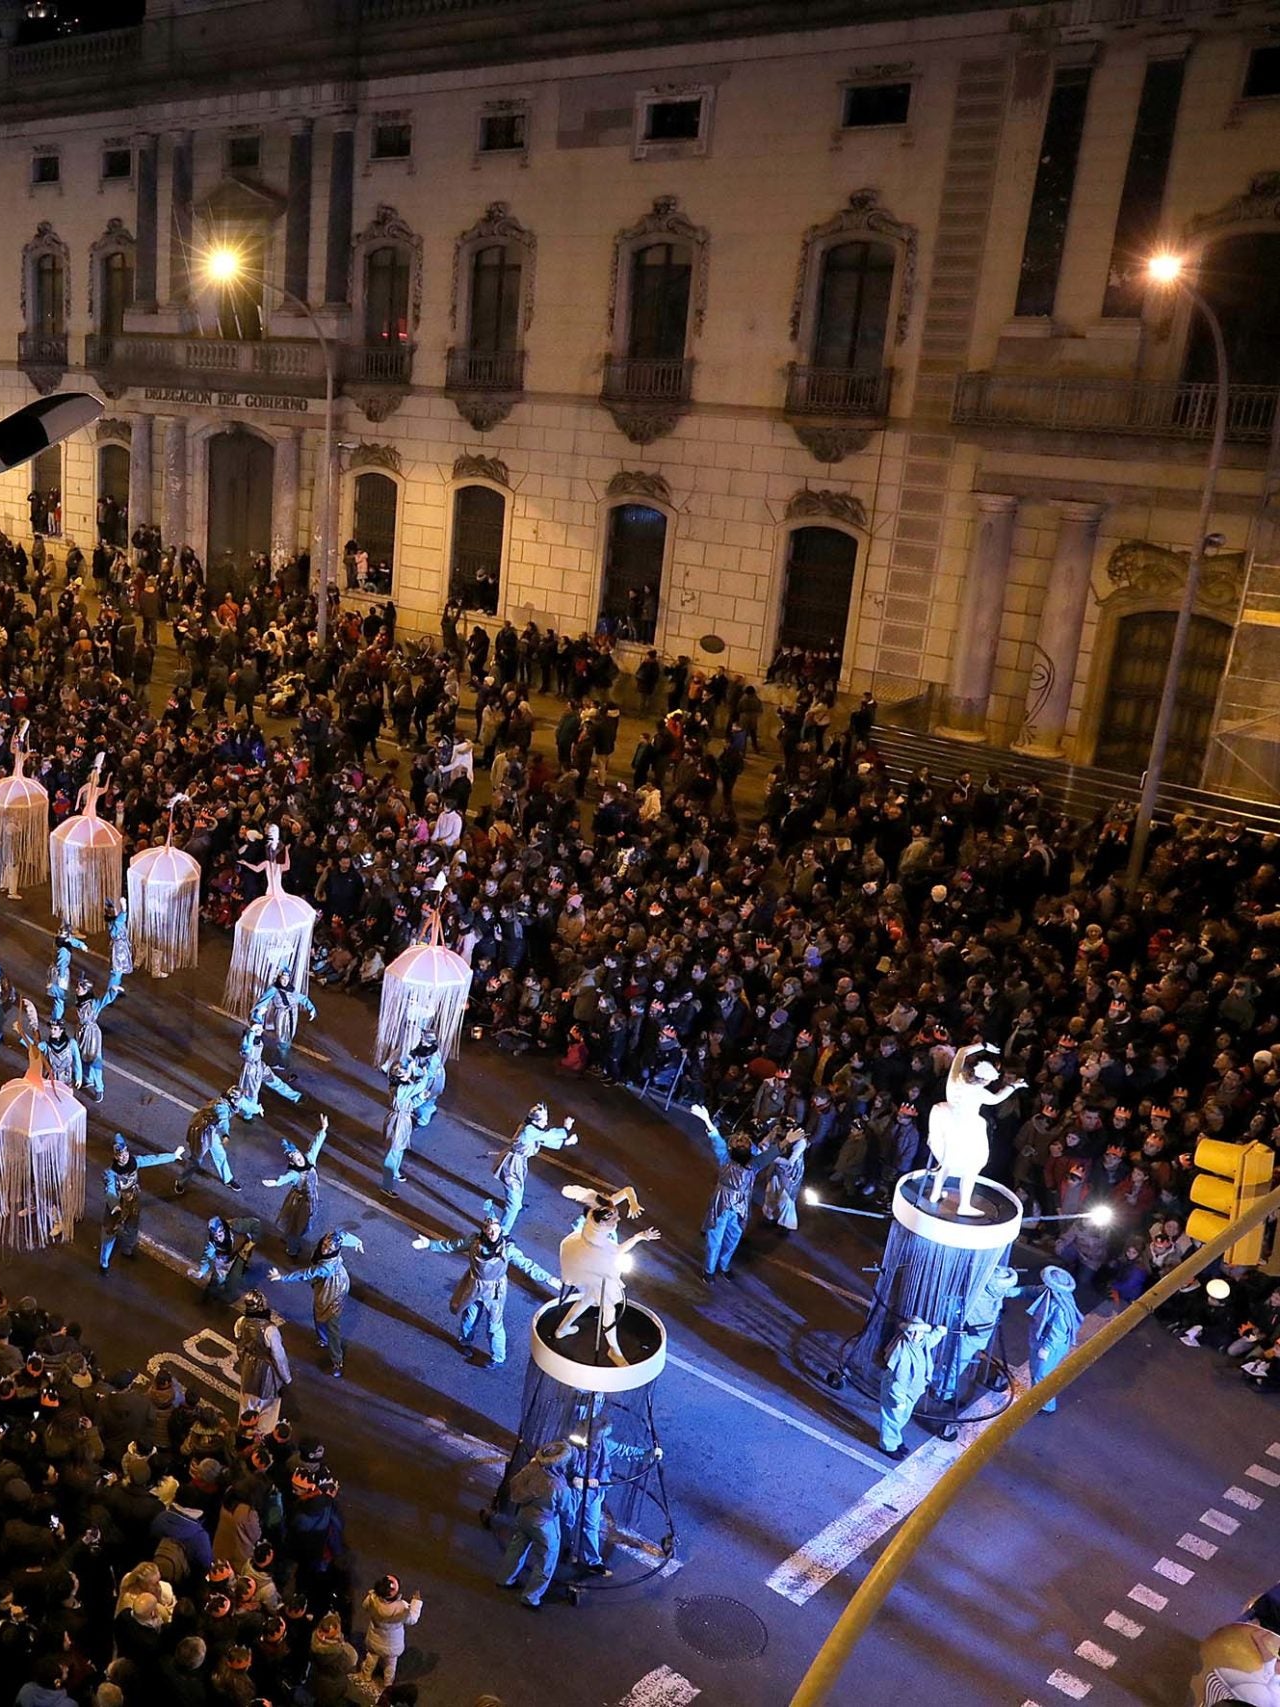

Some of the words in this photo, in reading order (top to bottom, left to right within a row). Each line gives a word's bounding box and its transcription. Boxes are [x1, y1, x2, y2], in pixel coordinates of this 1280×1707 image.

[144, 388, 212, 405] DELEGACION
[218, 393, 241, 407] DEL
[245, 395, 309, 412] GOBIERNO
